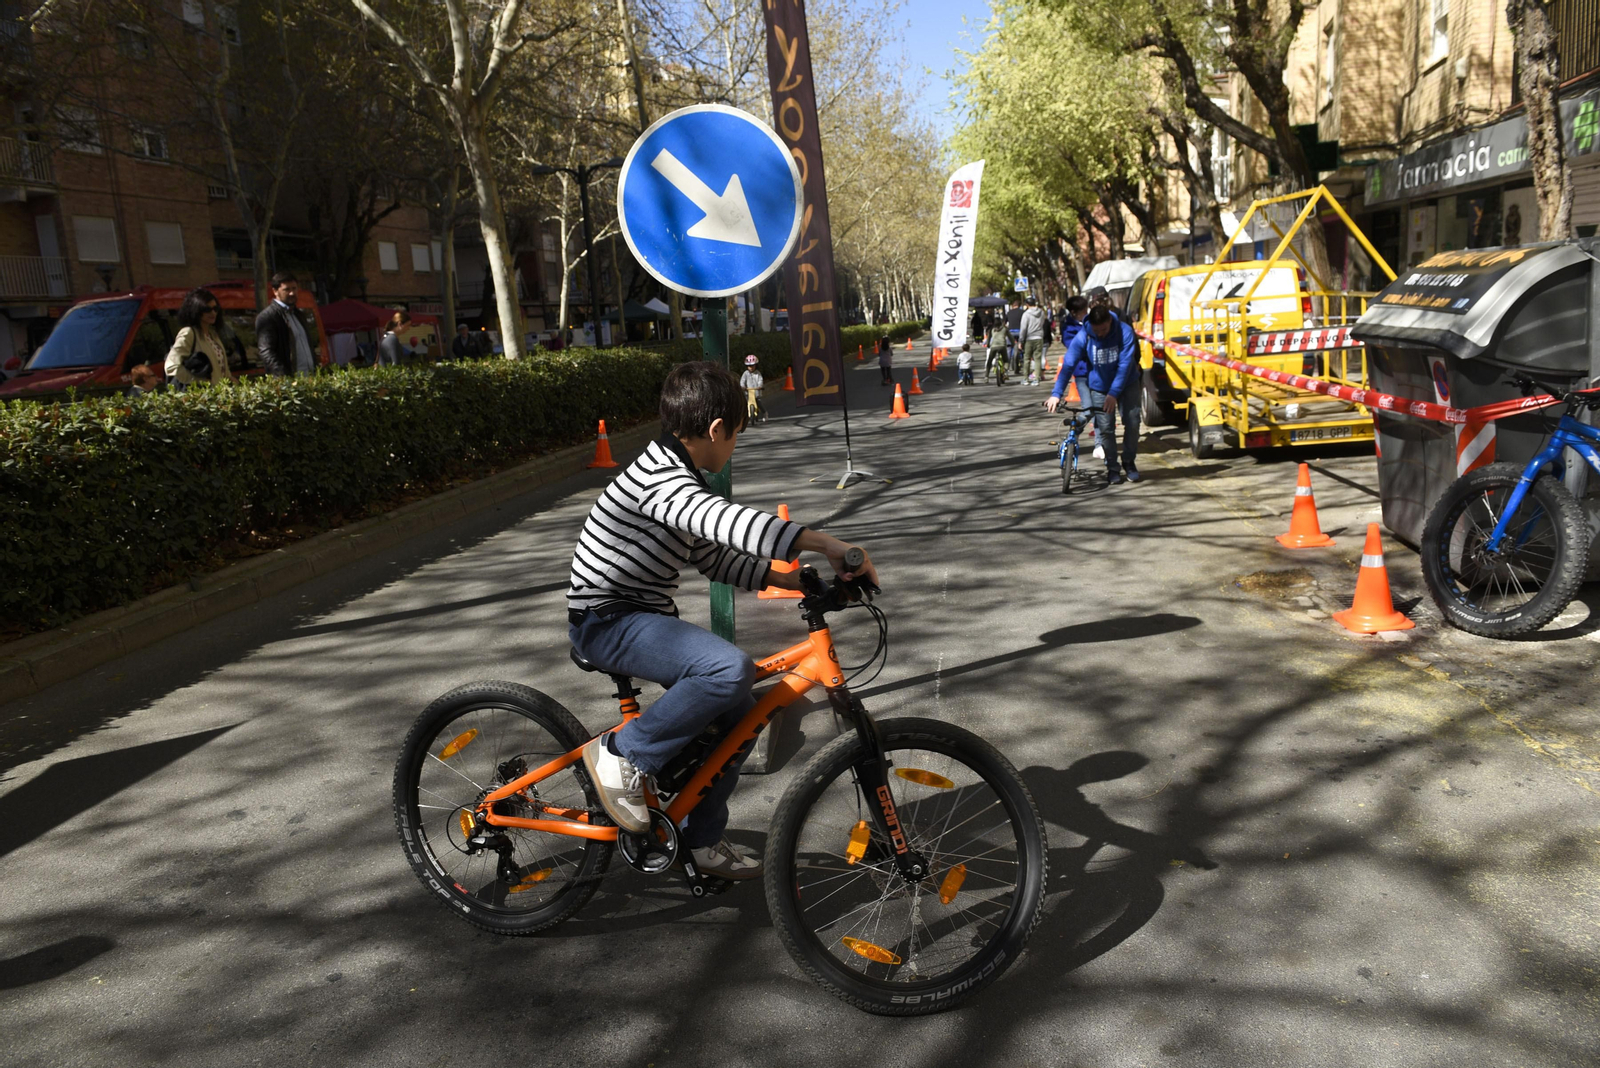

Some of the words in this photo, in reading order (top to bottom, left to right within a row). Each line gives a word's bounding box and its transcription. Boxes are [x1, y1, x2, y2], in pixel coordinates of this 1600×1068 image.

[1397, 139, 1490, 190] farmacia
[937, 296, 958, 341] Guad
[1249, 339, 1276, 348] CLUB
[1280, 334, 1339, 346] DEPORTIVO
[1330, 426, 1350, 438] GPP
[1470, 475, 1520, 486] SCHWALB
[399, 802, 423, 864] TABLE
[423, 868, 451, 899] TOP
[889, 949, 1008, 1004] SCHWALBE
